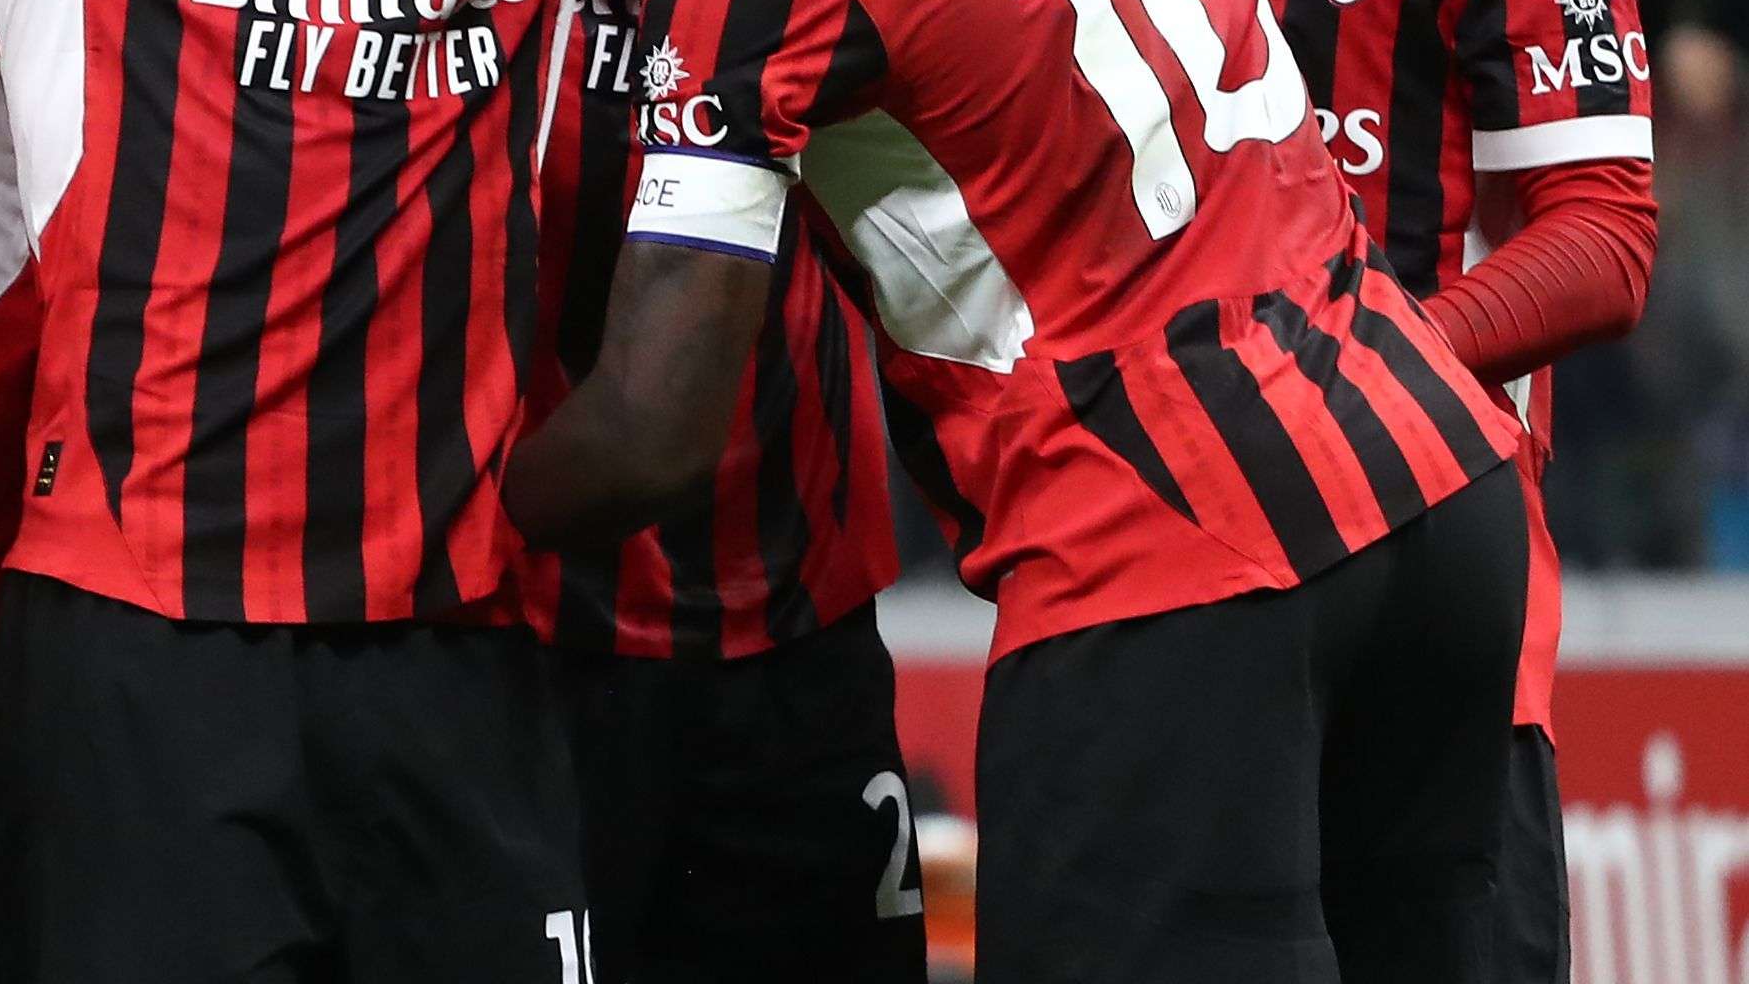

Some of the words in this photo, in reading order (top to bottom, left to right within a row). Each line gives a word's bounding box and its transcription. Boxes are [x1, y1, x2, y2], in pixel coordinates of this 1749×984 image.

[239, 19, 335, 93] FLY
[343, 24, 502, 102] BETTER
[1524, 30, 1651, 95] MSC
[861, 770, 924, 921] 2
[545, 909, 594, 984] 1
